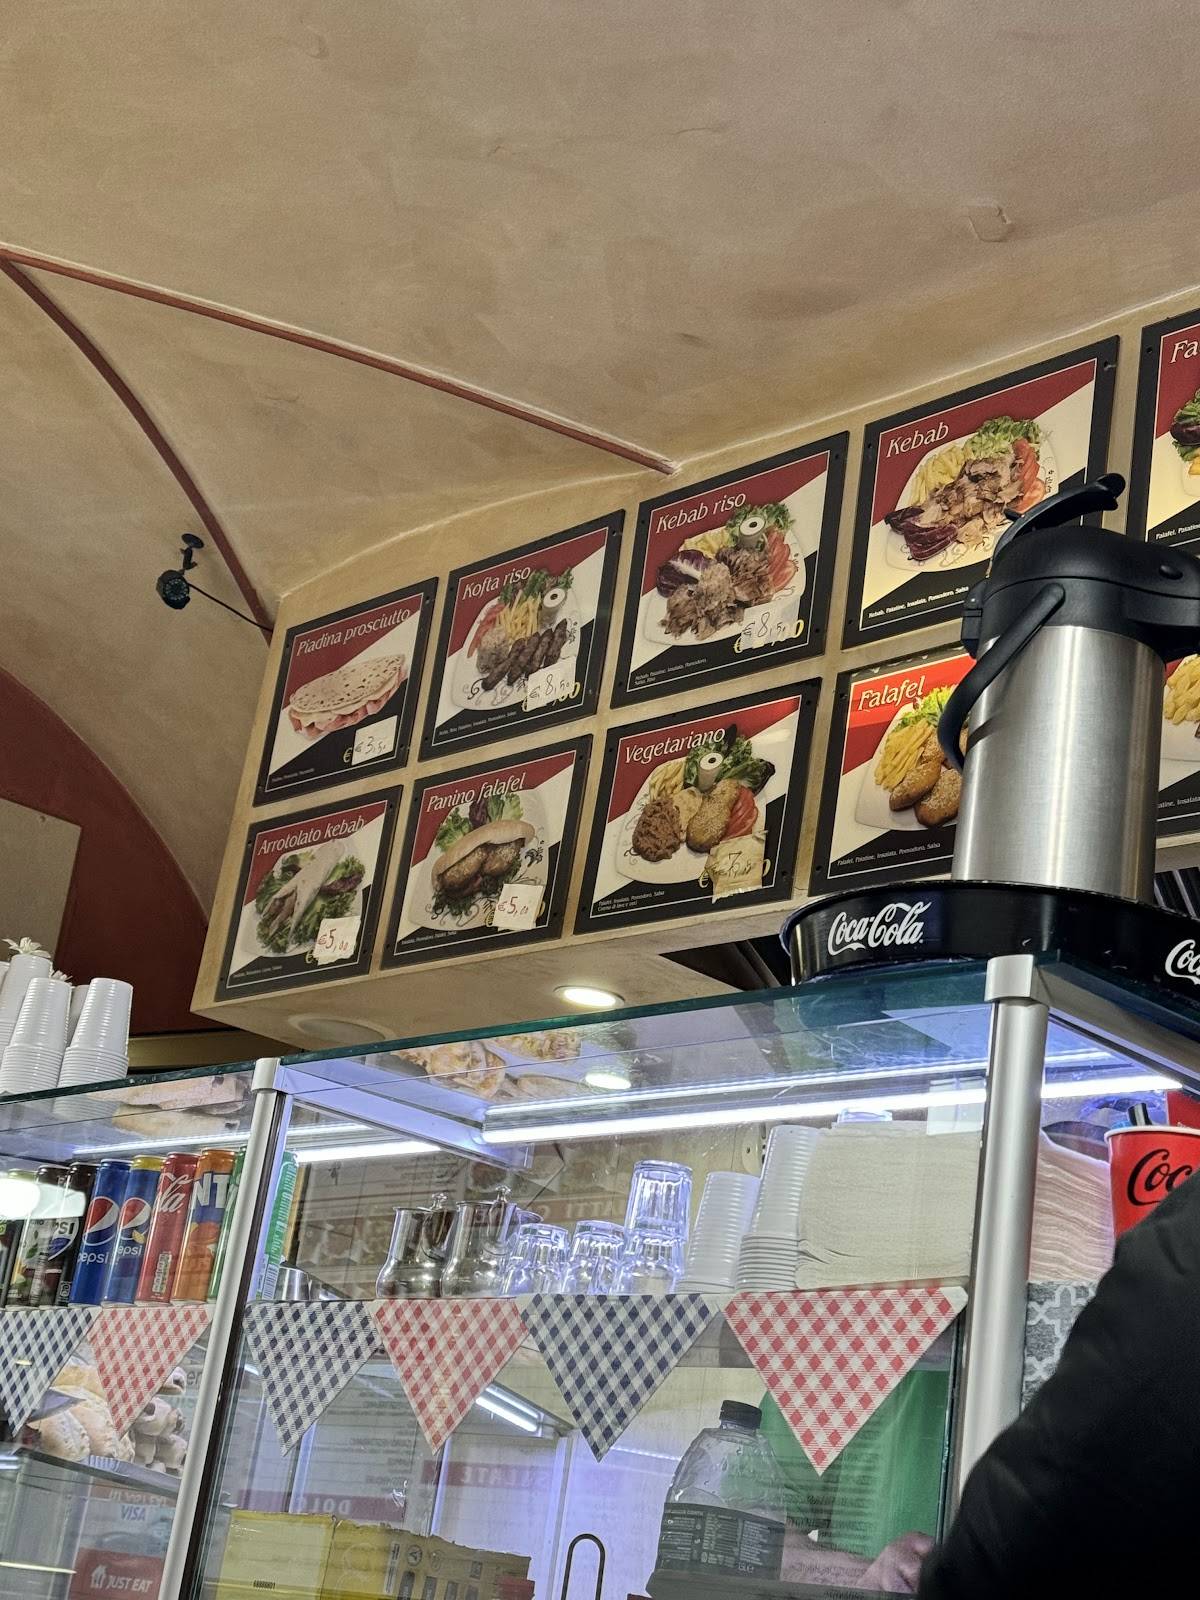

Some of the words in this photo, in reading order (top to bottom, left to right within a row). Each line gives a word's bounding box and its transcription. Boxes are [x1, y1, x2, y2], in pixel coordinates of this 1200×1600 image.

[885, 422, 950, 458] Kebab
[656, 502, 708, 534] Kebab
[712, 492, 746, 515] riso
[462, 576, 500, 601] Kofta
[503, 566, 531, 587] riso
[296, 632, 341, 656] Piadina
[343, 608, 411, 644] prosciutto
[858, 675, 926, 711] Falafel
[624, 728, 726, 764] Vegetariano
[427, 789, 475, 813] Panino
[477, 772, 526, 804] falafel
[257, 830, 322, 856] Arrotolato
[324, 815, 366, 840] kebab
[117, 1245, 143, 1257] epsi
[120, 1505, 146, 1521] VISA
[132, 1578, 154, 1593] EAT
